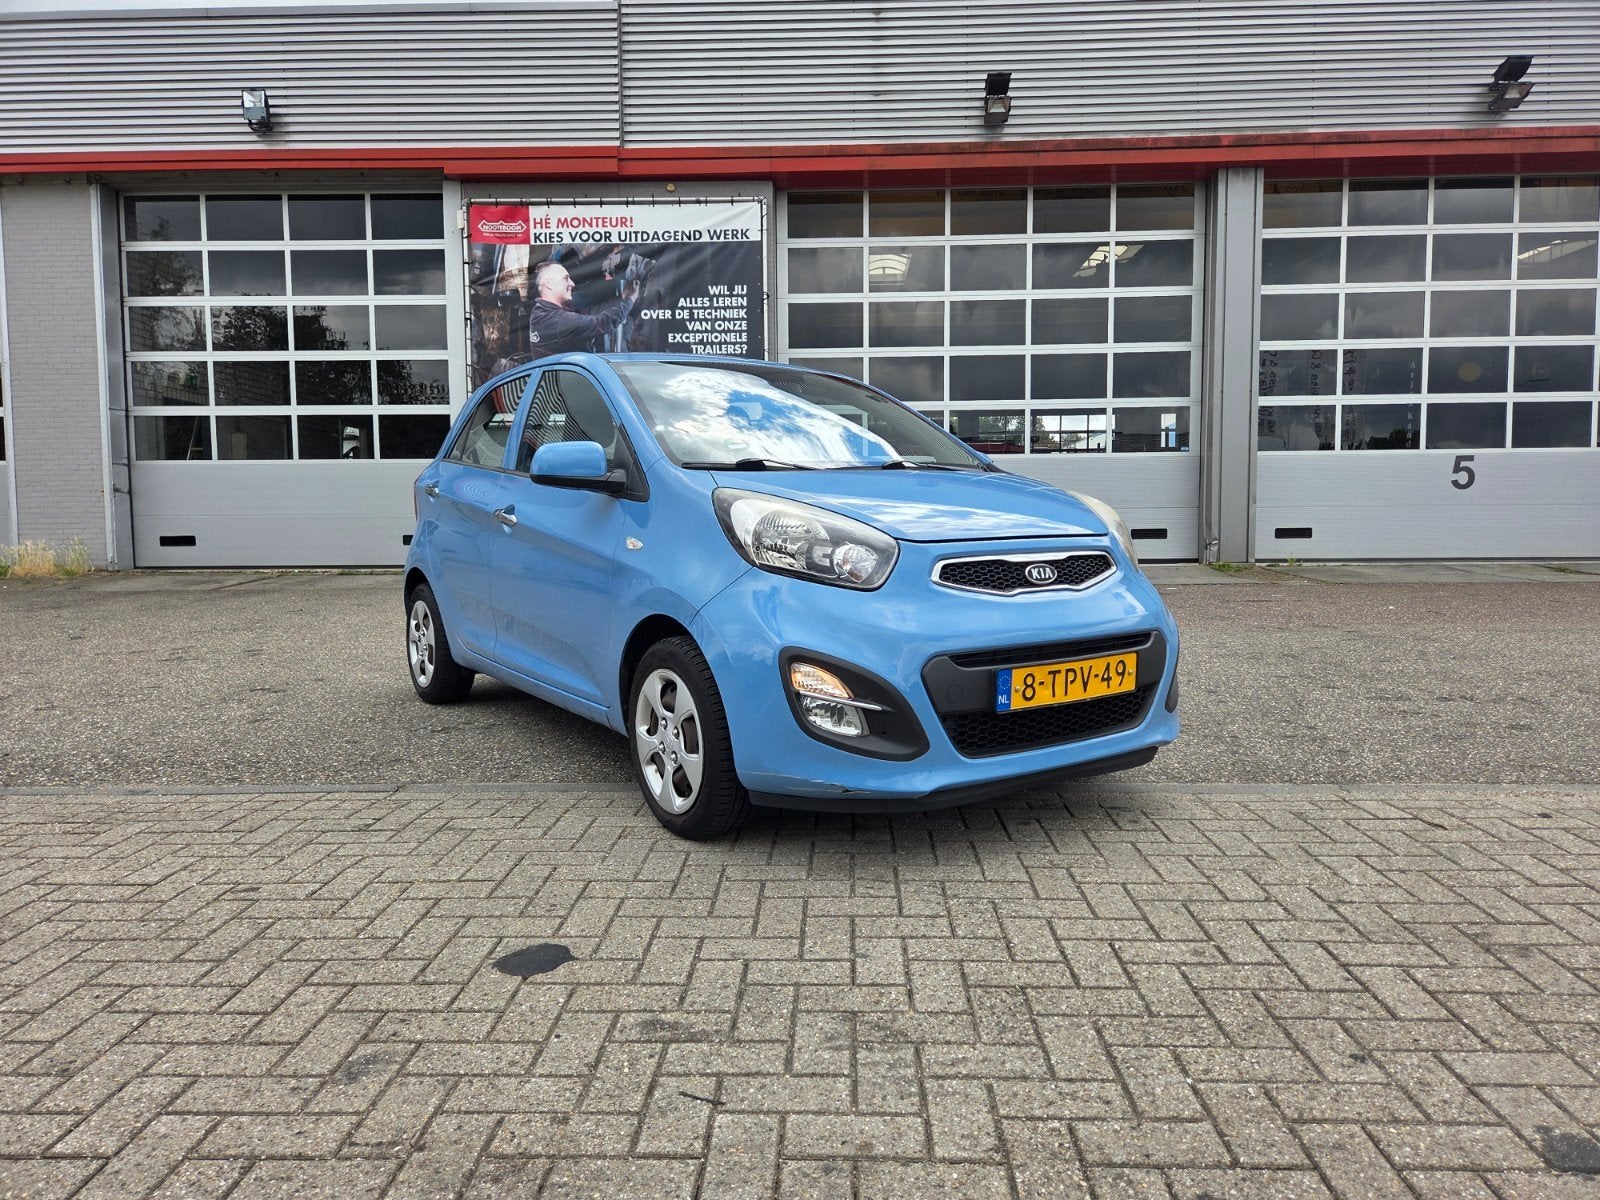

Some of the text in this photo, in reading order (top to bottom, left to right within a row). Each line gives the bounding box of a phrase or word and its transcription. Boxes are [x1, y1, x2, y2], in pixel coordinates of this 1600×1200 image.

[533, 214, 634, 229] HÉ MONTEUR!
[533, 231, 564, 243] KIES
[569, 230, 613, 243] VOOR
[618, 230, 702, 242] UITDAGEND
[706, 229, 750, 241] WERK
[708, 285, 747, 295] WIL JIJ
[678, 297, 747, 307] ALLES LEREN
[640, 309, 747, 319] OVER DE TECHNIEK
[686, 321, 747, 331] VAN ONZE
[668, 333, 747, 342] EXCEPTIONELE
[691, 345, 747, 354] TRAILERS?
[1450, 454, 1476, 490] 5
[1031, 567, 1054, 580] KIA
[998, 659, 1127, 705] NL 8-TPV-49
